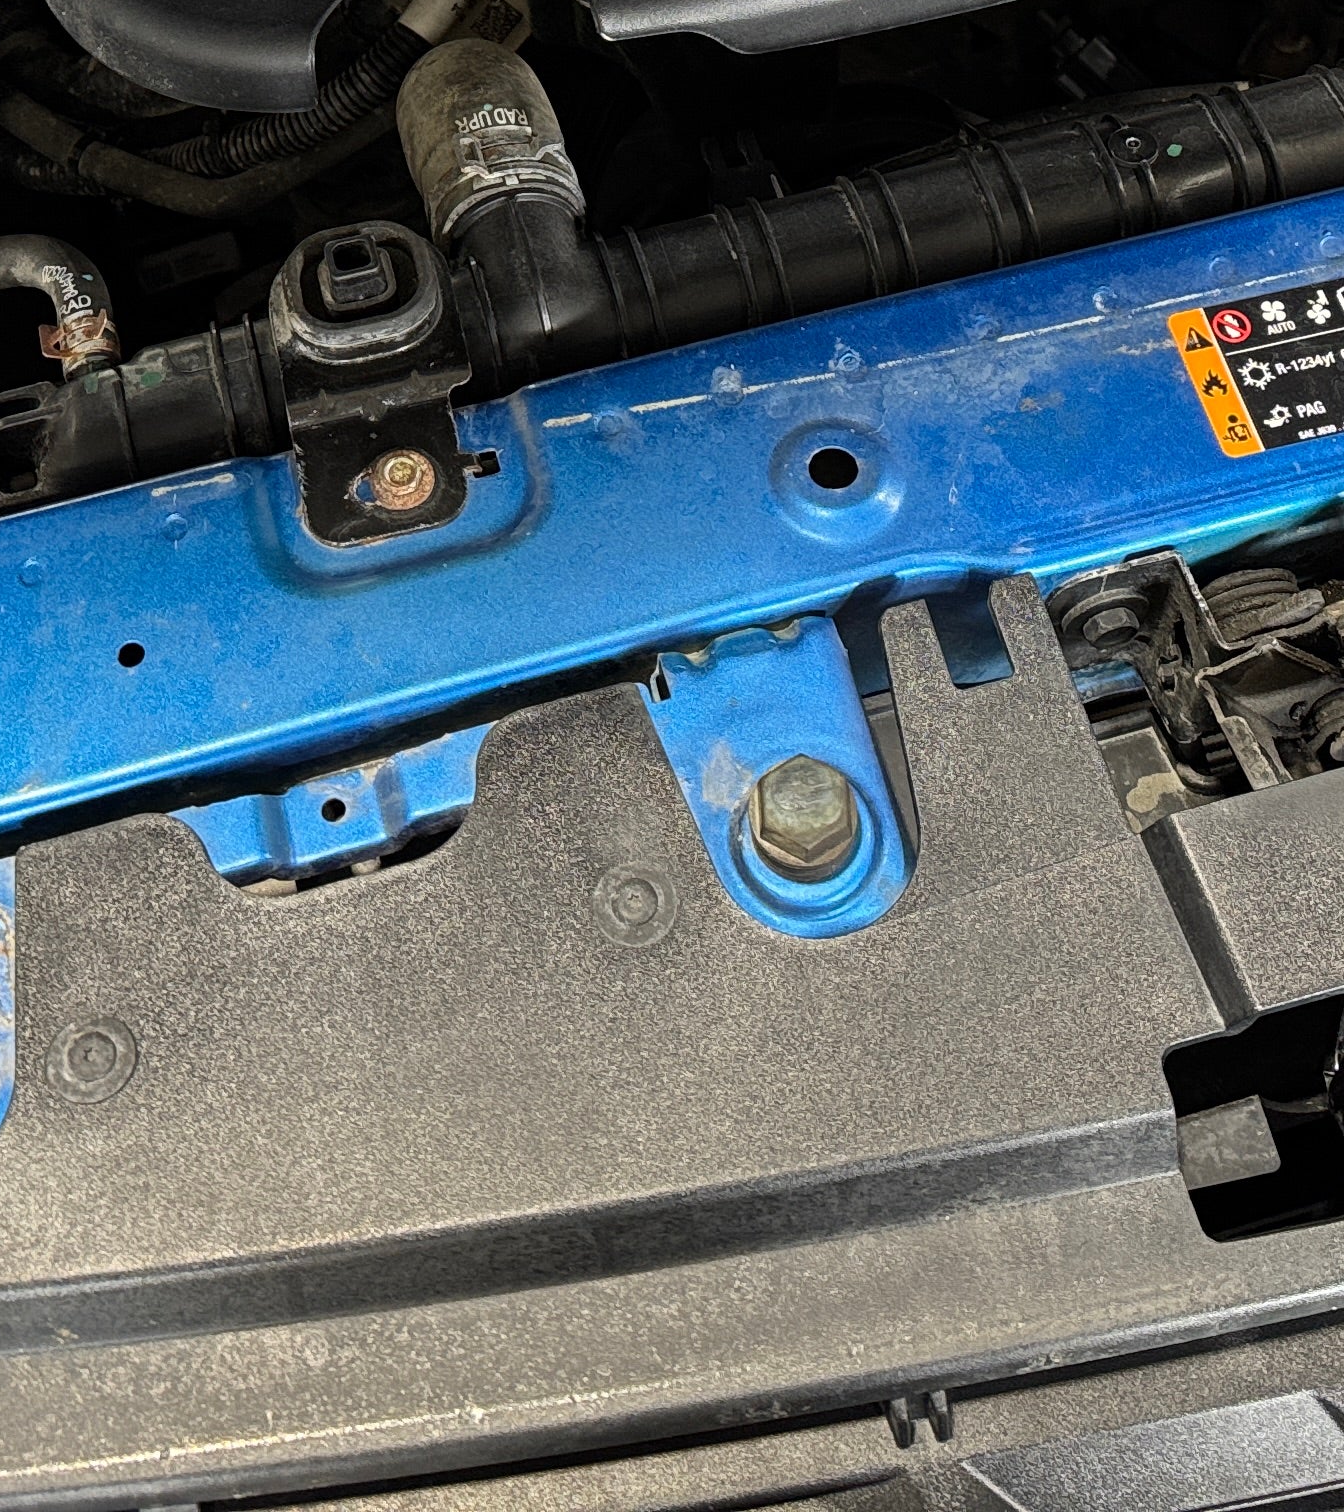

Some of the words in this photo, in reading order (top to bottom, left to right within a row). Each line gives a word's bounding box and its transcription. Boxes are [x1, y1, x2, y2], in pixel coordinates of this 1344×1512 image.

[454, 110, 491, 134] UPR
[494, 107, 529, 128] RAD
[1267, 319, 1296, 336] AUTO
[1274, 349, 1336, 376] R-1234yf
[1295, 400, 1327, 419] PAG
